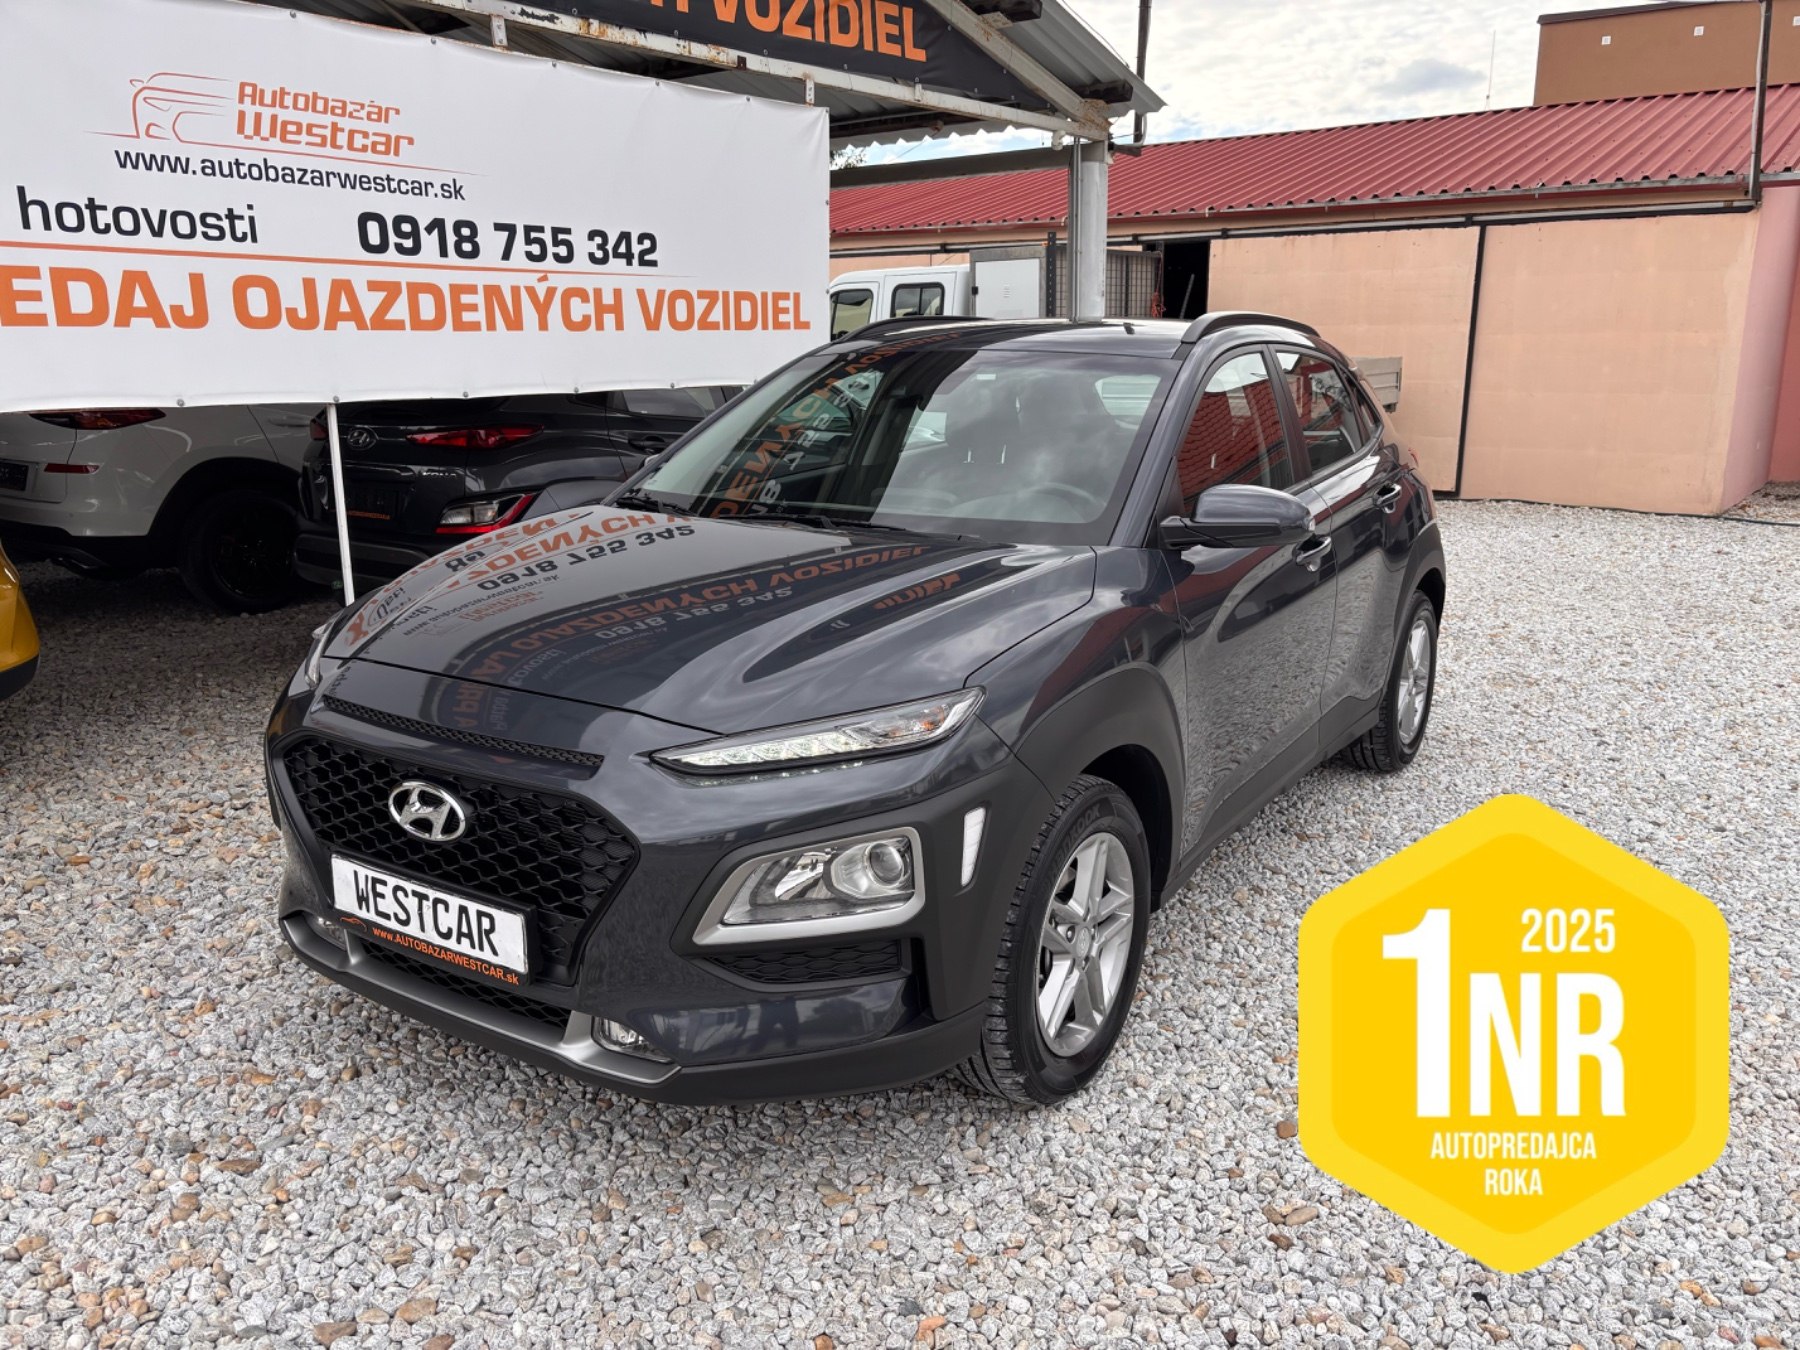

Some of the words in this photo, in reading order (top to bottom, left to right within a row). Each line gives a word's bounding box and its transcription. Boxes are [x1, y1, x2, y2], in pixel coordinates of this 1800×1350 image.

[238, 81, 401, 125] Autobazár
[236, 110, 415, 157] Westcar
[114, 149, 466, 202] www.autobazarwestcar.sk
[16, 185, 259, 244] hotovosti
[357, 211, 480, 260] 0918
[493, 222, 575, 264] 755
[587, 229, 659, 268] 342
[231, 273, 622, 332] OJAZDENÝCH
[636, 288, 811, 331] VOZIDIEL
[353, 870, 499, 957] WESTCAR
[372, 927, 520, 985] www.AUTOBAZARWESTCAR.sk
